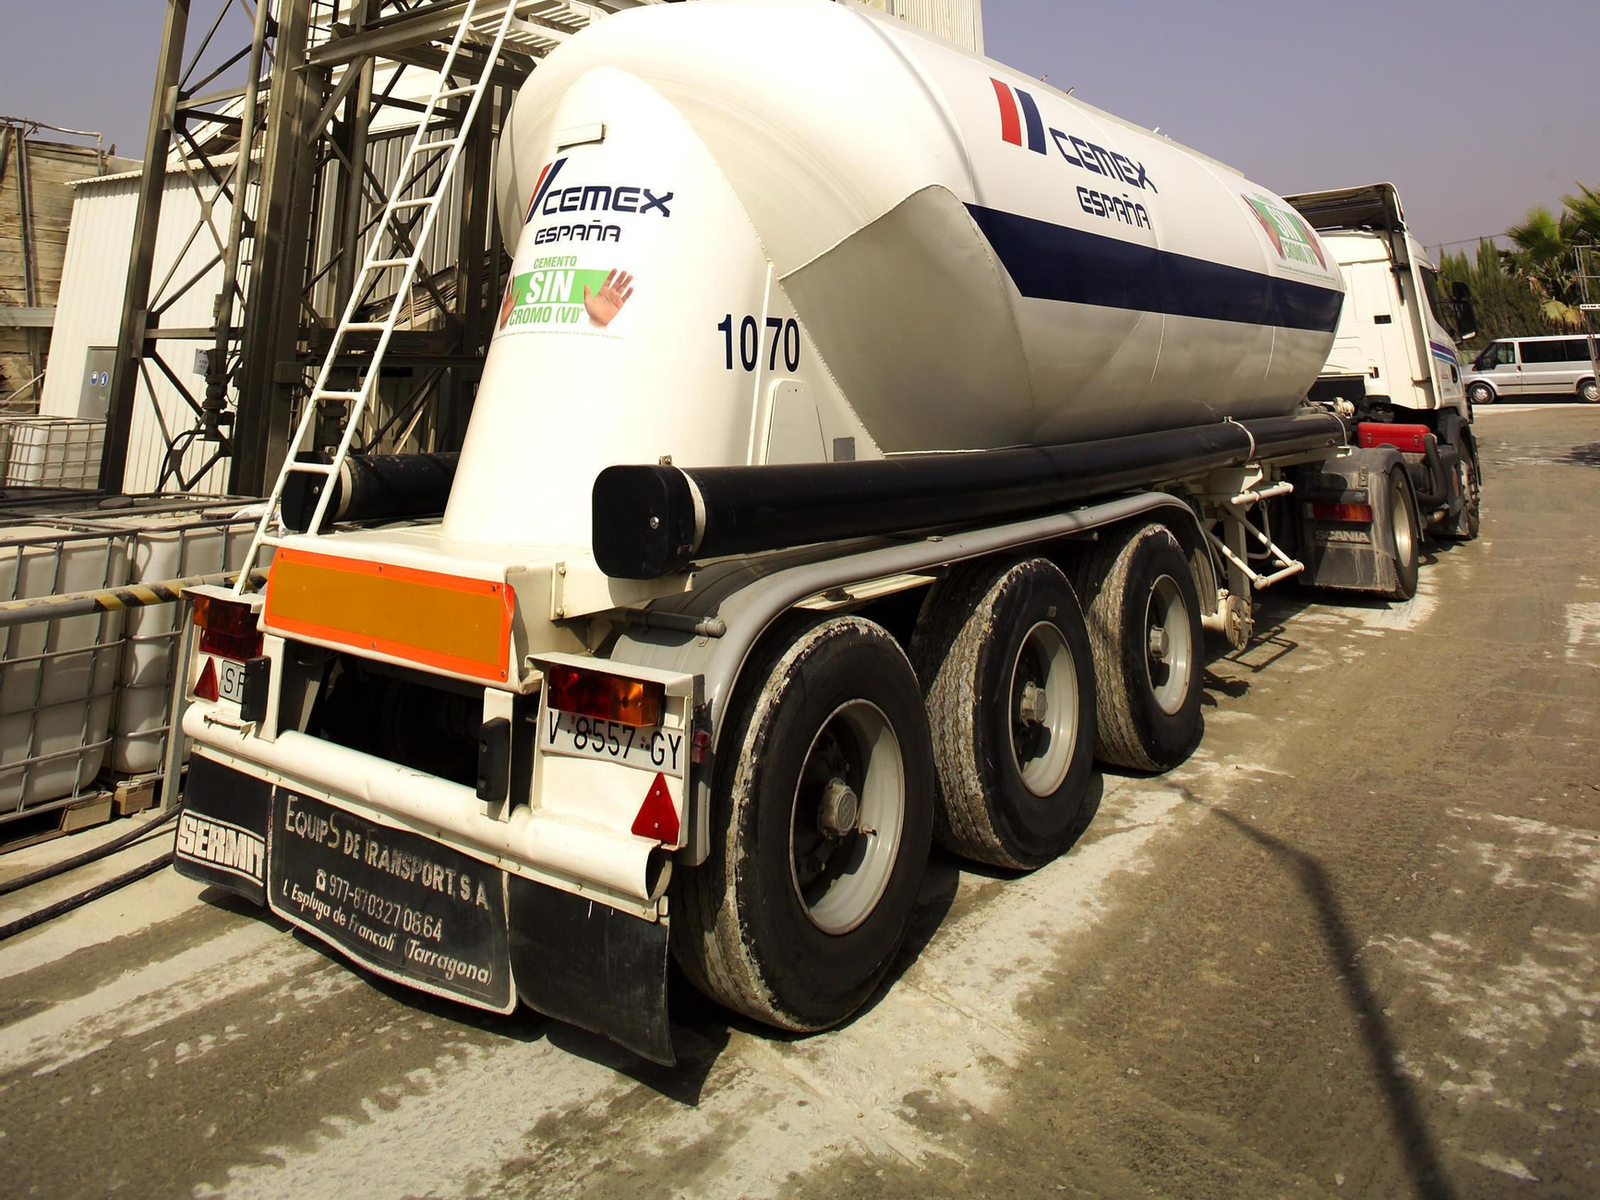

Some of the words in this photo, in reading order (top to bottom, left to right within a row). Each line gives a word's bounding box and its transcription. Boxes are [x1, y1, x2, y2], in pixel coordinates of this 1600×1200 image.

[1049, 127, 1159, 194] CEMEX
[543, 186, 674, 218] CEMEX
[1076, 186, 1151, 230] ESPAÑA
[535, 220, 621, 245] ESPAÑA
[1264, 204, 1303, 242] SIN
[533, 256, 577, 270] CEMENTO
[525, 270, 575, 304] SIN
[509, 306, 552, 326] CROMO
[717, 313, 800, 372] 1070
[1315, 530, 1370, 544] SCANIA
[179, 815, 265, 879] SERMIT
[343, 829, 361, 860] DE
[333, 906, 346, 926] de
[404, 937, 493, 985] (Tarragona)
